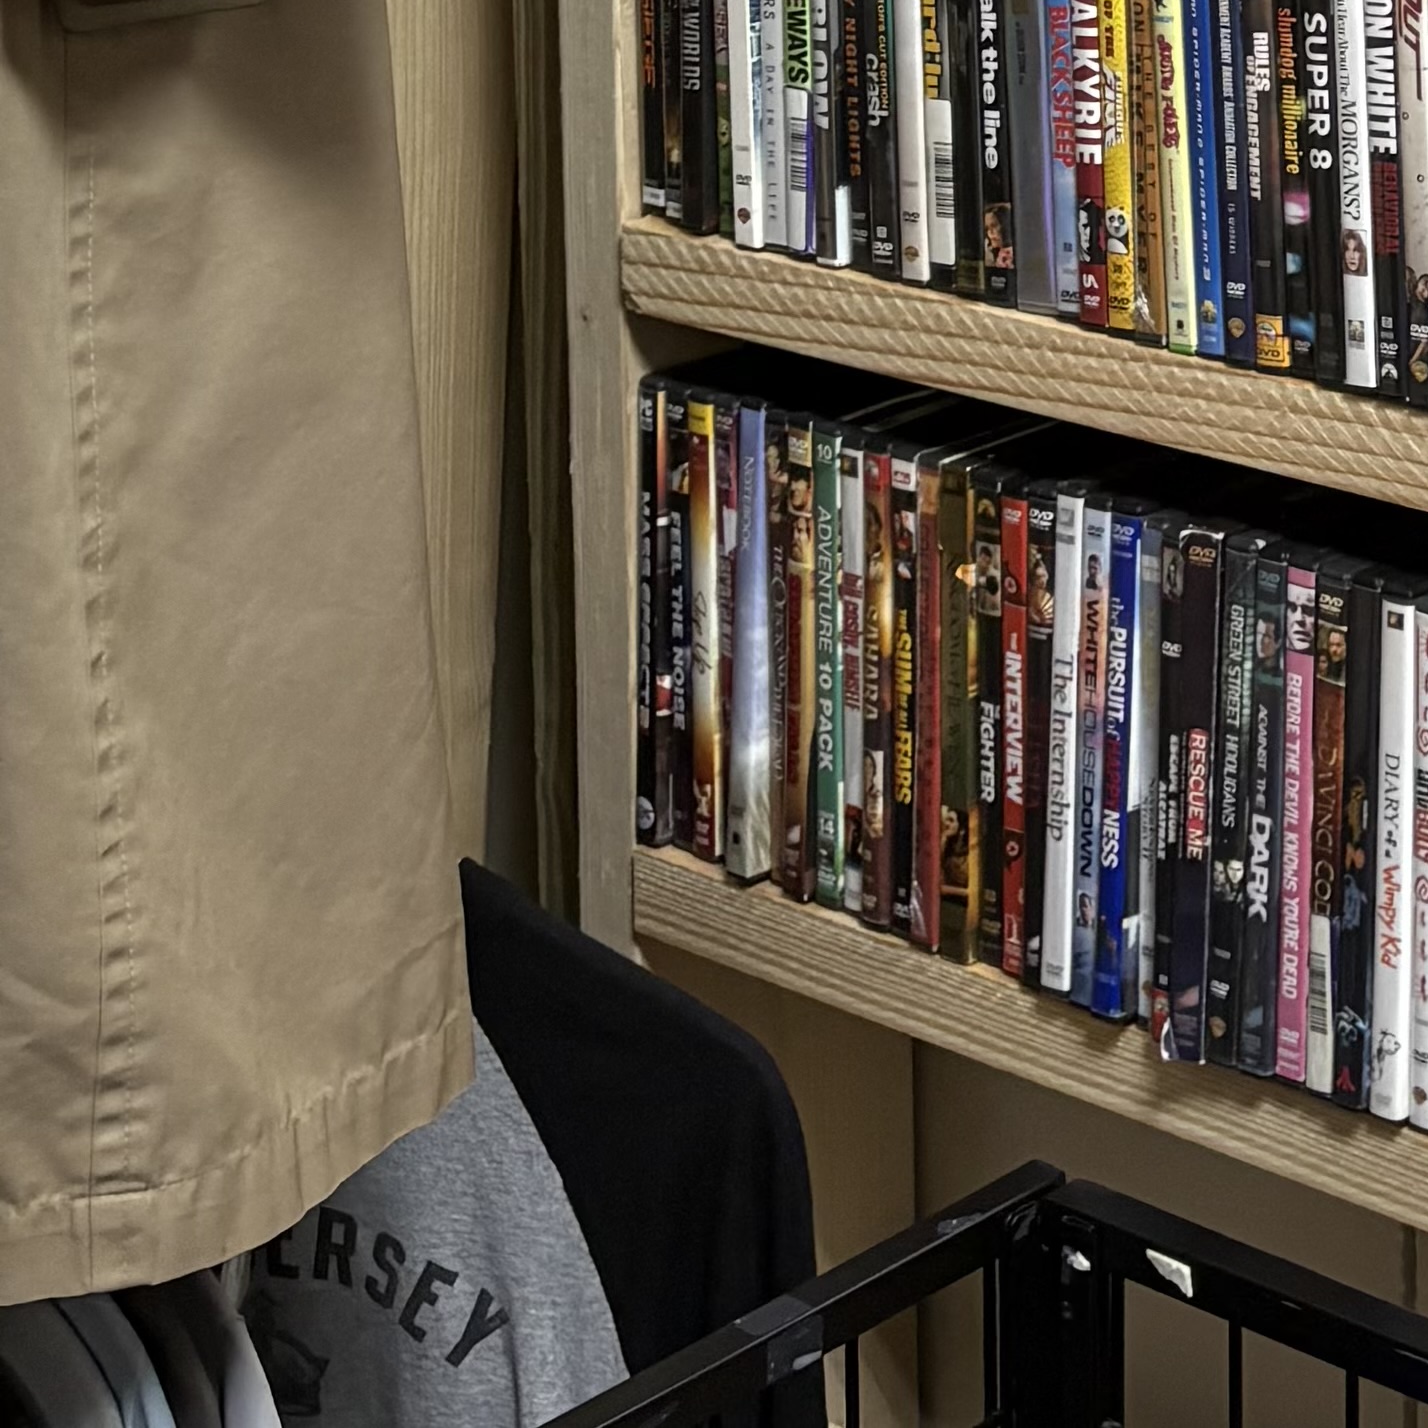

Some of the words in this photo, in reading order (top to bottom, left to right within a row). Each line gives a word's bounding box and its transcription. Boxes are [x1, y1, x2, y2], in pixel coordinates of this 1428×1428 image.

[981, 46, 998, 104] the
[1305, 12, 1331, 136] SUPER
[984, 110, 1000, 169] line
[1309, 148, 1332, 170] 8
[253, 1205, 511, 1368] ERSEY
